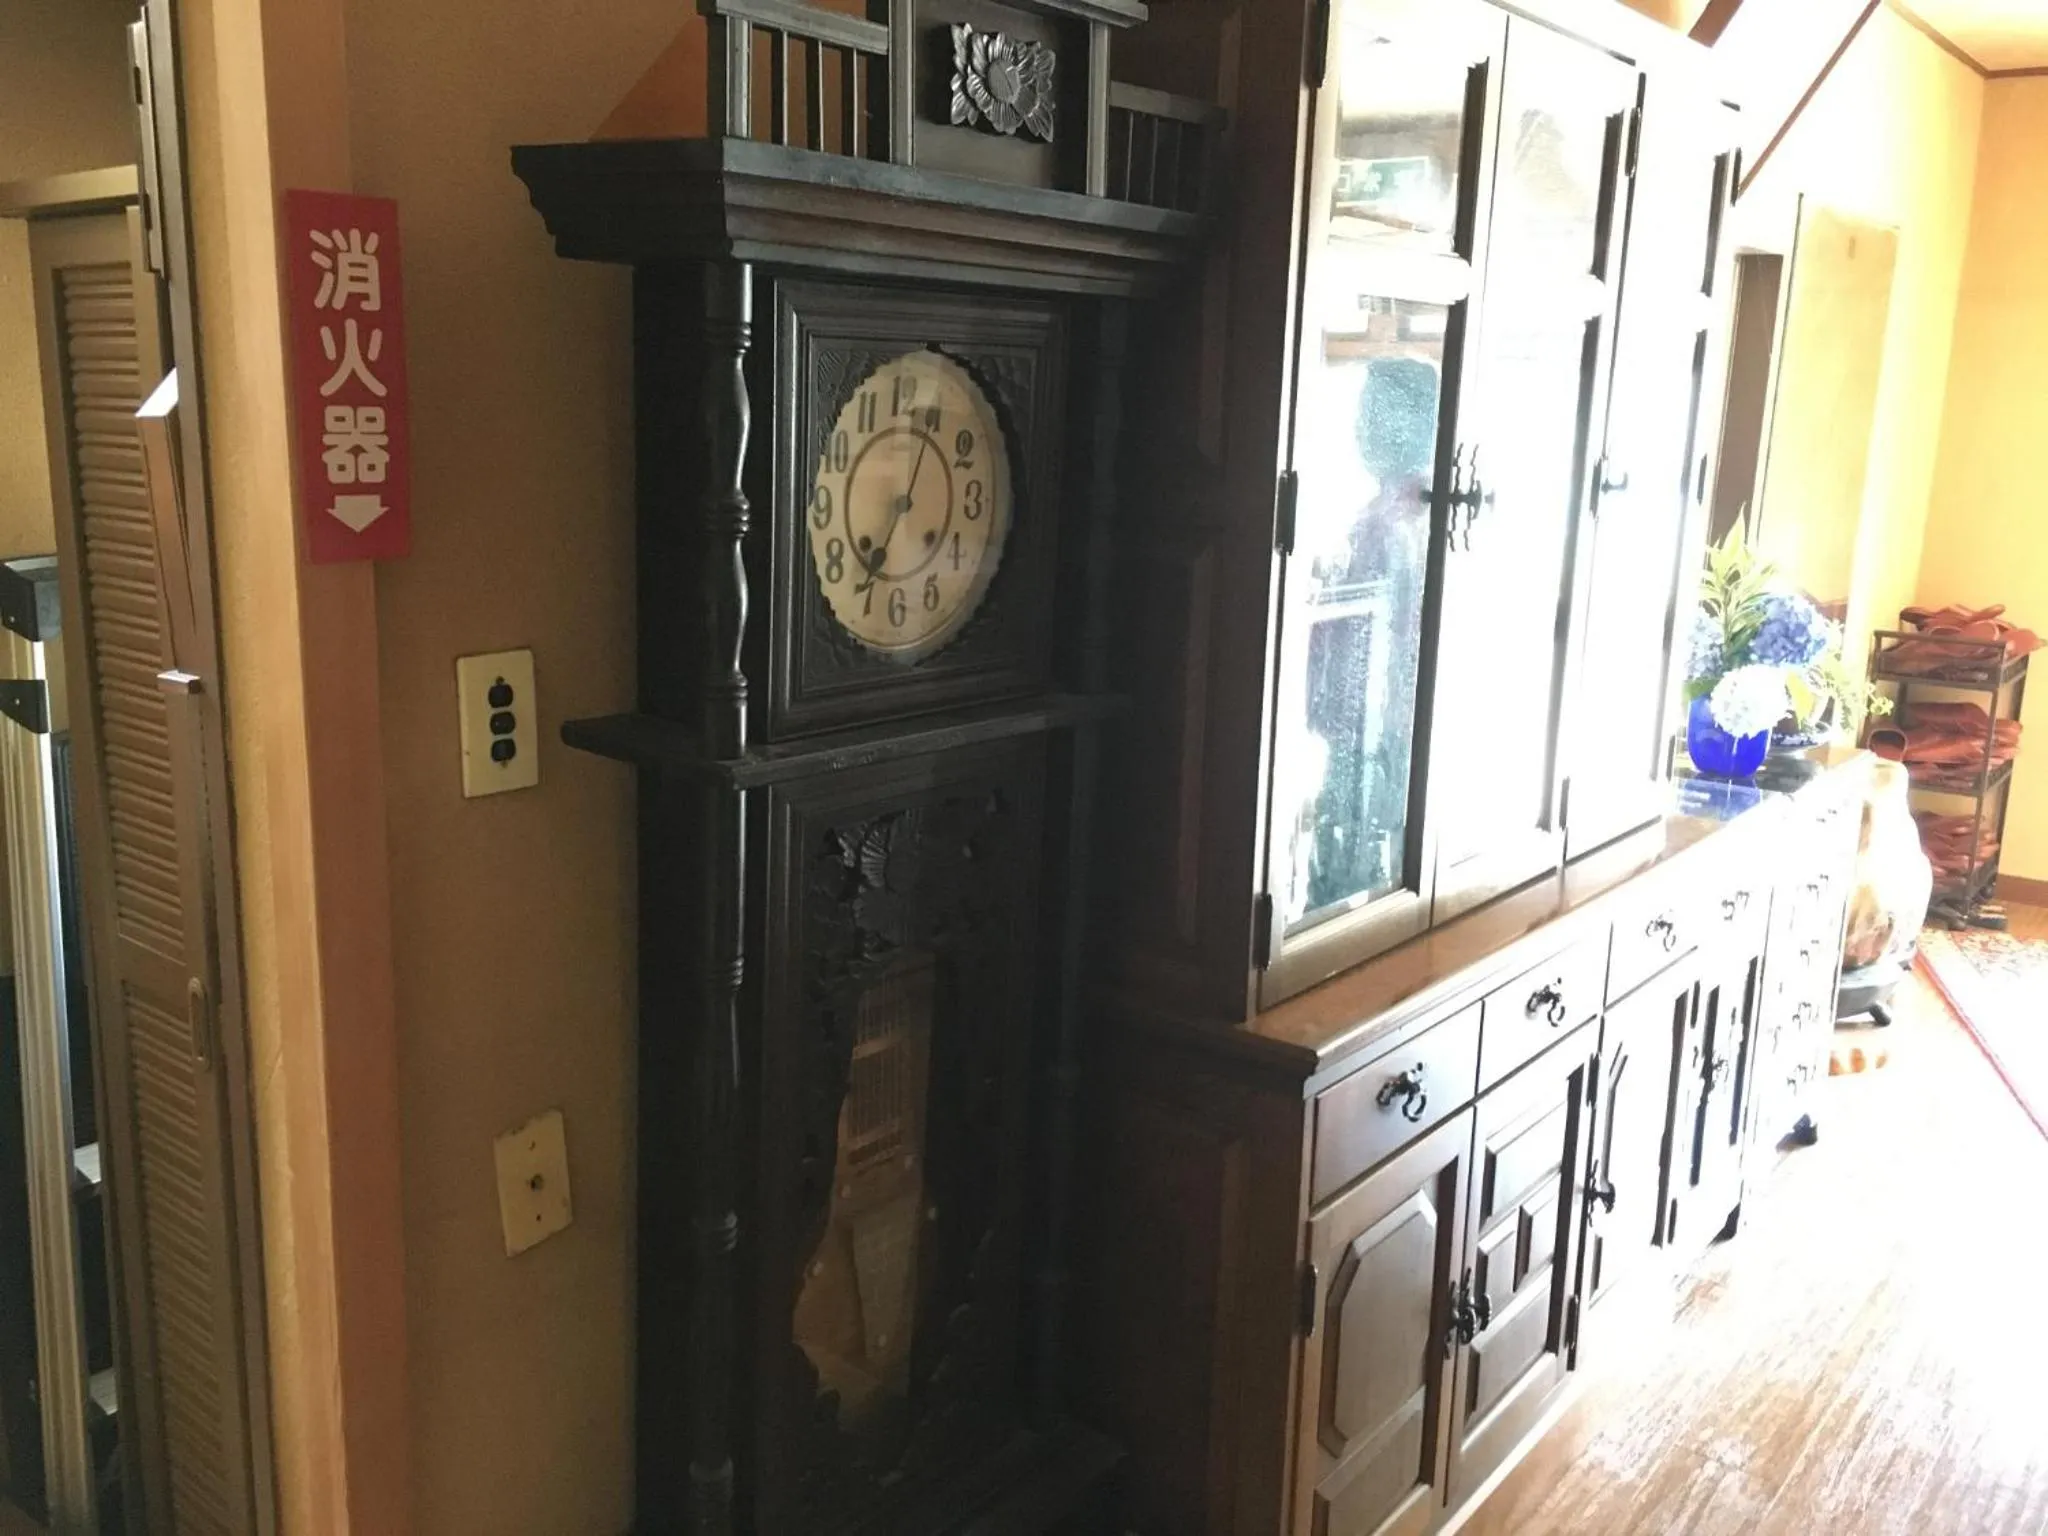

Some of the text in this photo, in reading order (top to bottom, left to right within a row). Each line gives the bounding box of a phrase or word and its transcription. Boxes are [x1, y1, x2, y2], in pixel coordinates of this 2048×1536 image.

[310, 228, 389, 484] 消火器
[858, 392, 876, 433] 11
[824, 431, 849, 473] 10
[954, 429, 974, 470] 2
[813, 485, 833, 530] 9
[964, 480, 982, 521] 3
[825, 538, 844, 584] 8
[947, 532, 967, 571] 4
[854, 582, 874, 618] 7
[887, 587, 907, 628] 6
[924, 573, 940, 612] 5
